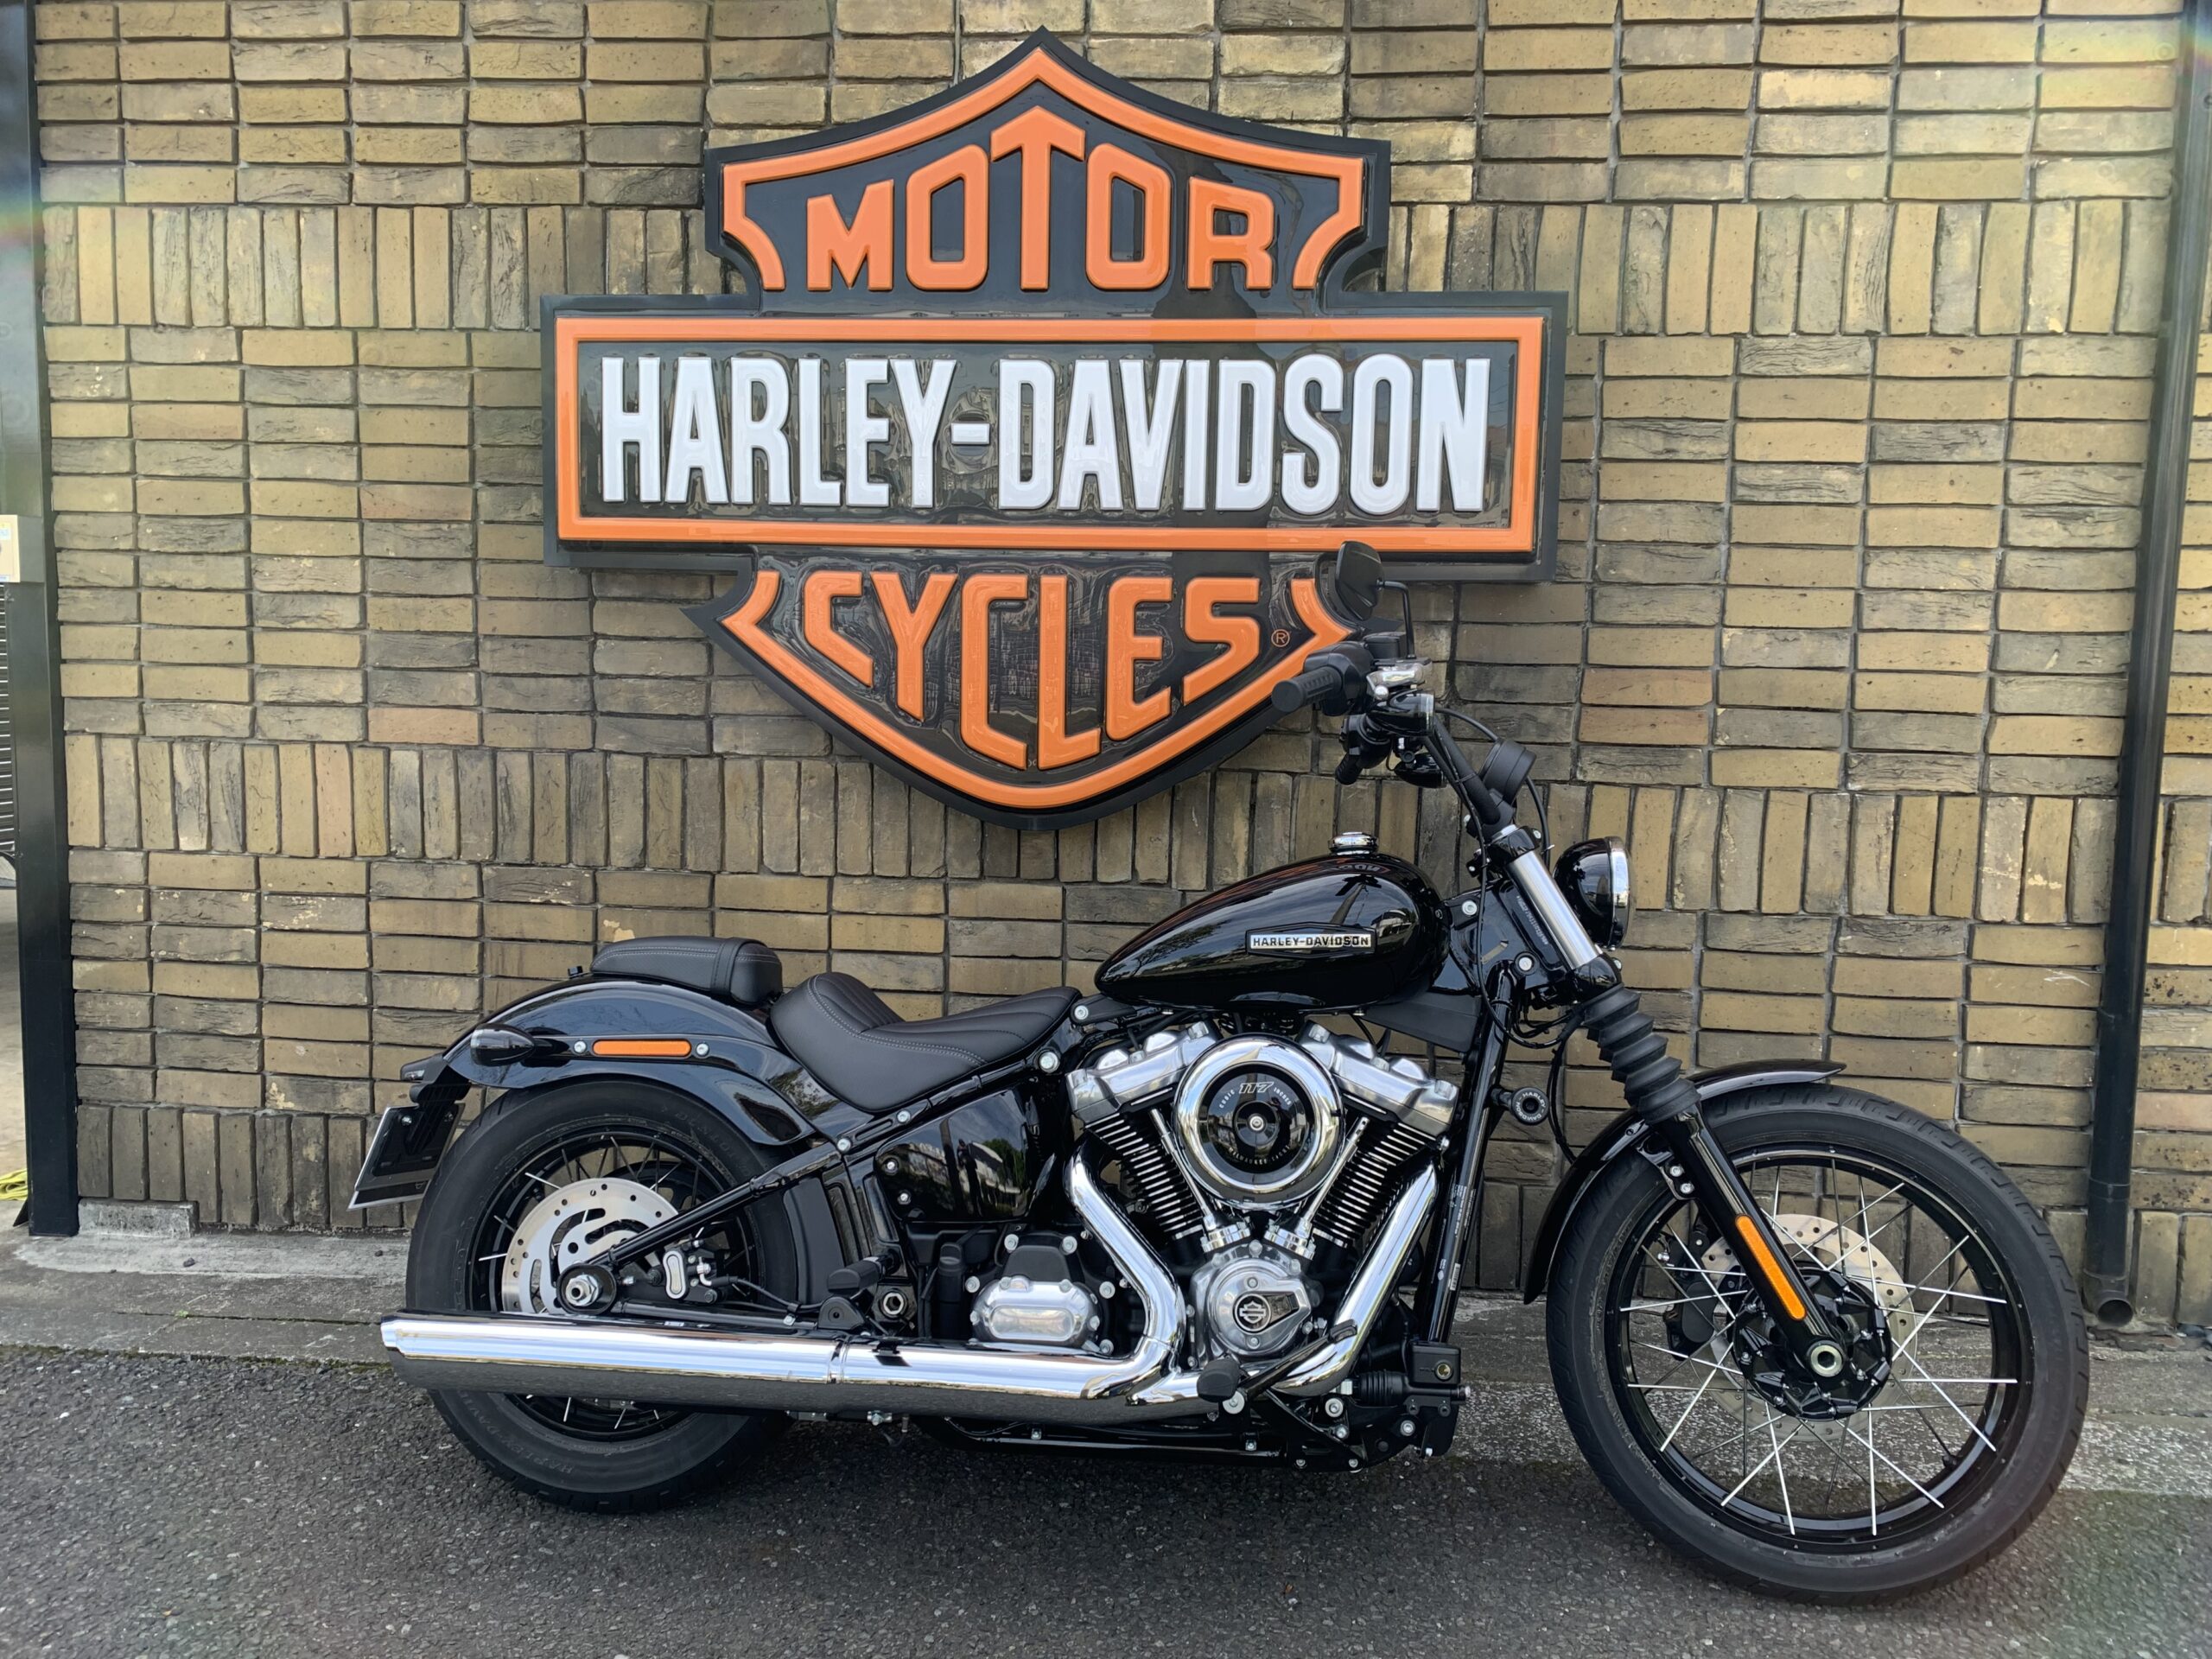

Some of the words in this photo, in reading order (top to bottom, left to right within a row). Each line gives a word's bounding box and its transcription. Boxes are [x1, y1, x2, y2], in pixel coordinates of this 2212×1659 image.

[806, 105, 1275, 291] MOTOR
[601, 353, 1491, 514] HARLEY-DAVIDSON
[804, 571, 1262, 770] CYCLES
[1253, 935, 1370, 947] HARLEY-DAVIDSON
[1238, 1082, 1274, 1094] 117
